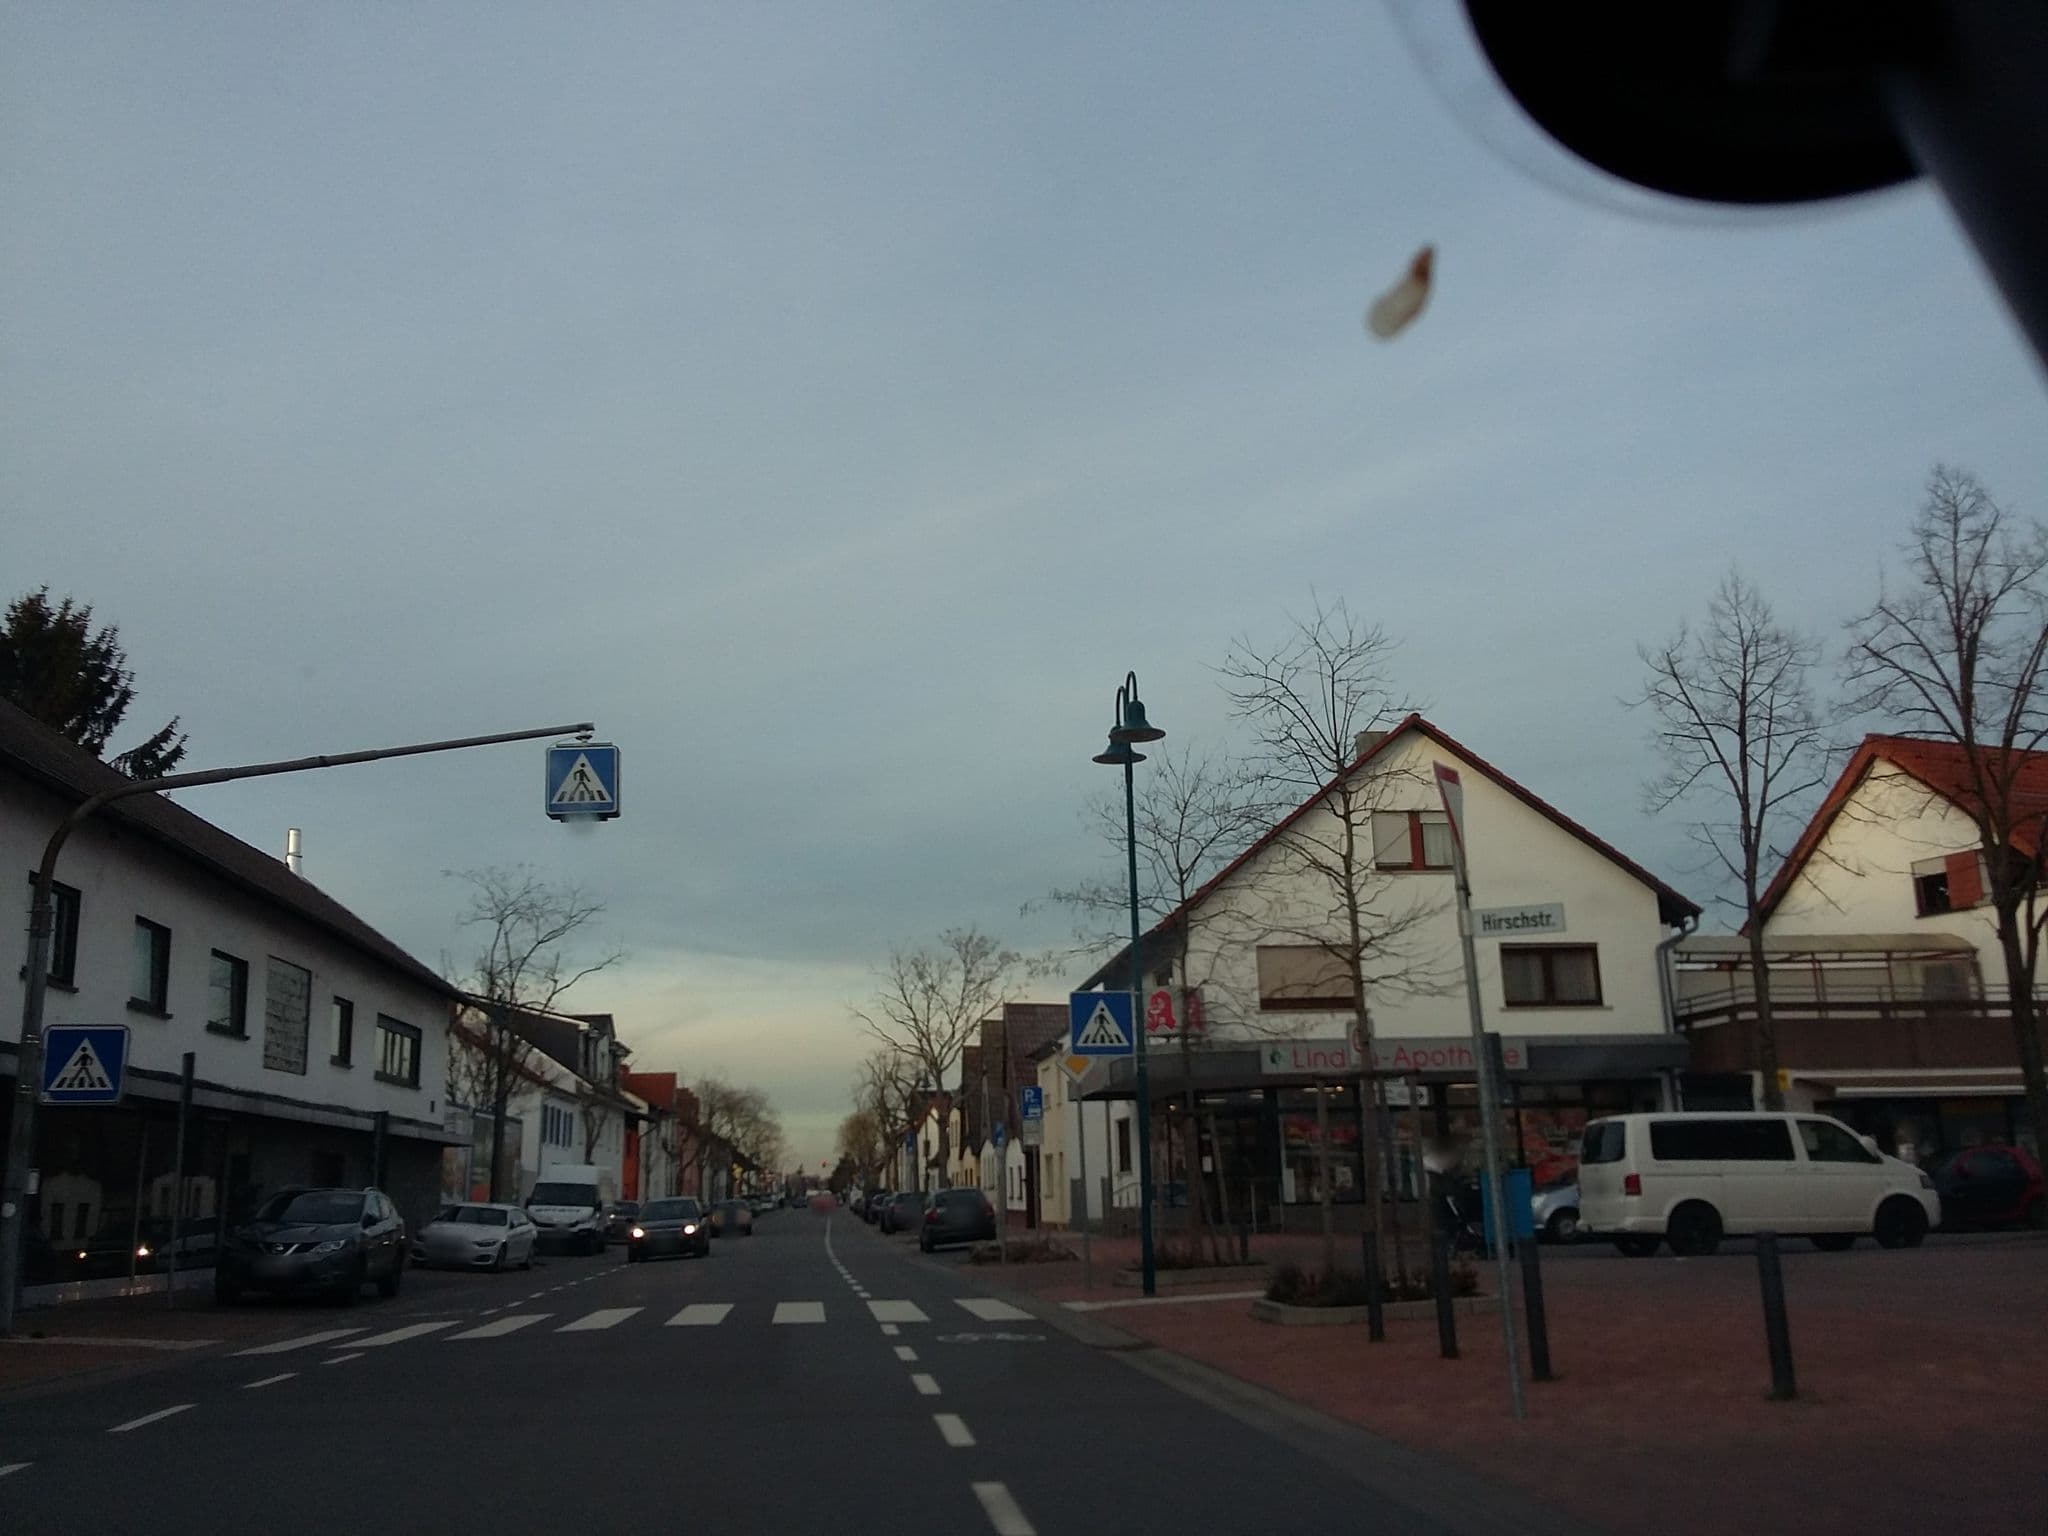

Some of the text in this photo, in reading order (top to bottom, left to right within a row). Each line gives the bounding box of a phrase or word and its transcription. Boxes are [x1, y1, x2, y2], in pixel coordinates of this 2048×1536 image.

[1481, 912, 1556, 932] Hirschstr.
[1292, 1045, 1520, 1070] Lind-Apothe
[1024, 1088, 1035, 1103] P
